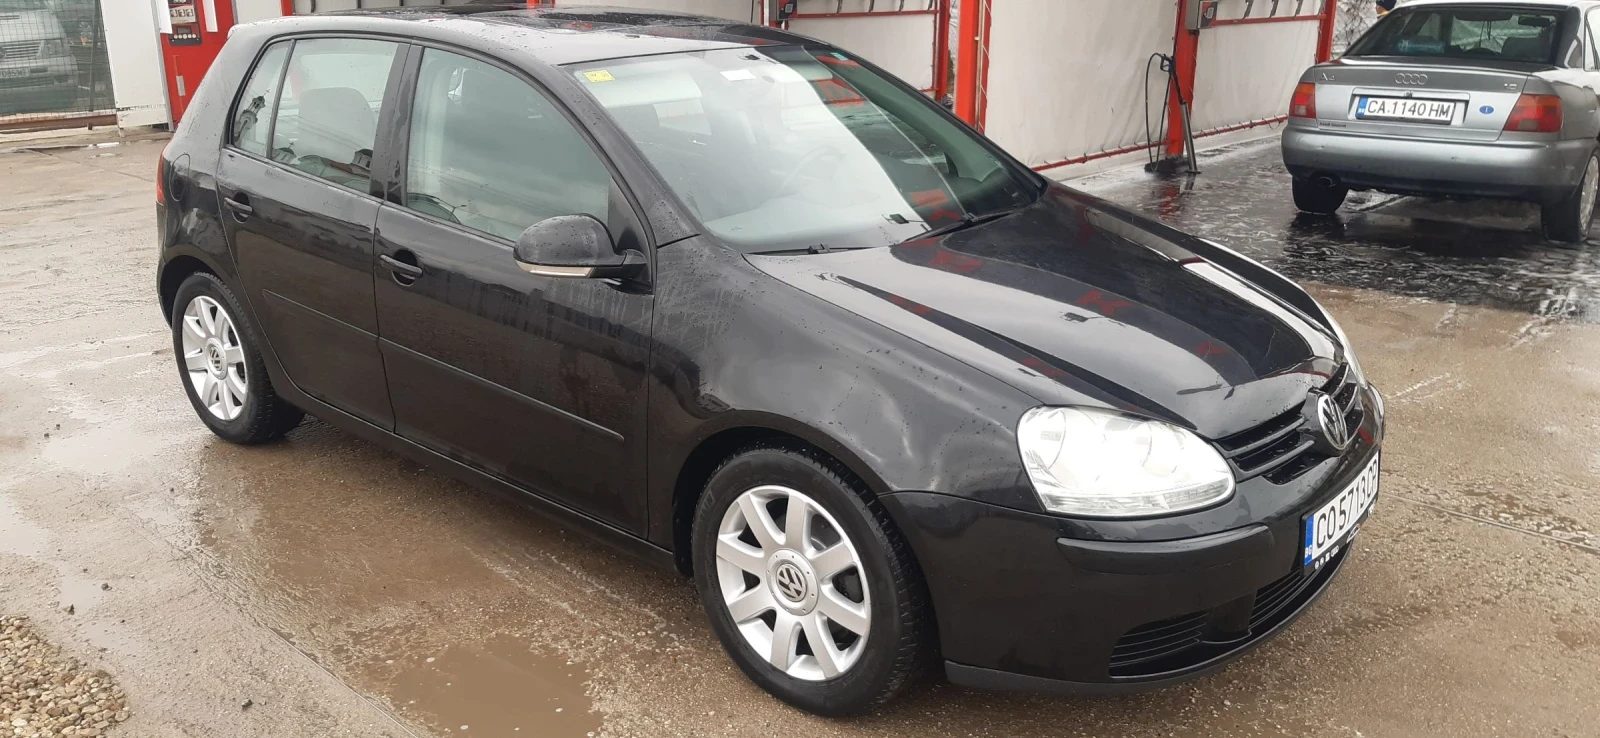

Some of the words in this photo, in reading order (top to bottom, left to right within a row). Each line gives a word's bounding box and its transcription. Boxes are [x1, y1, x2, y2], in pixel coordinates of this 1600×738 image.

[1392, 101, 1426, 116] 1140
[1428, 103, 1451, 118] HM
[1316, 505, 1336, 549] CO
[1339, 475, 1366, 531] 5713
[1304, 545, 1313, 558] BG
